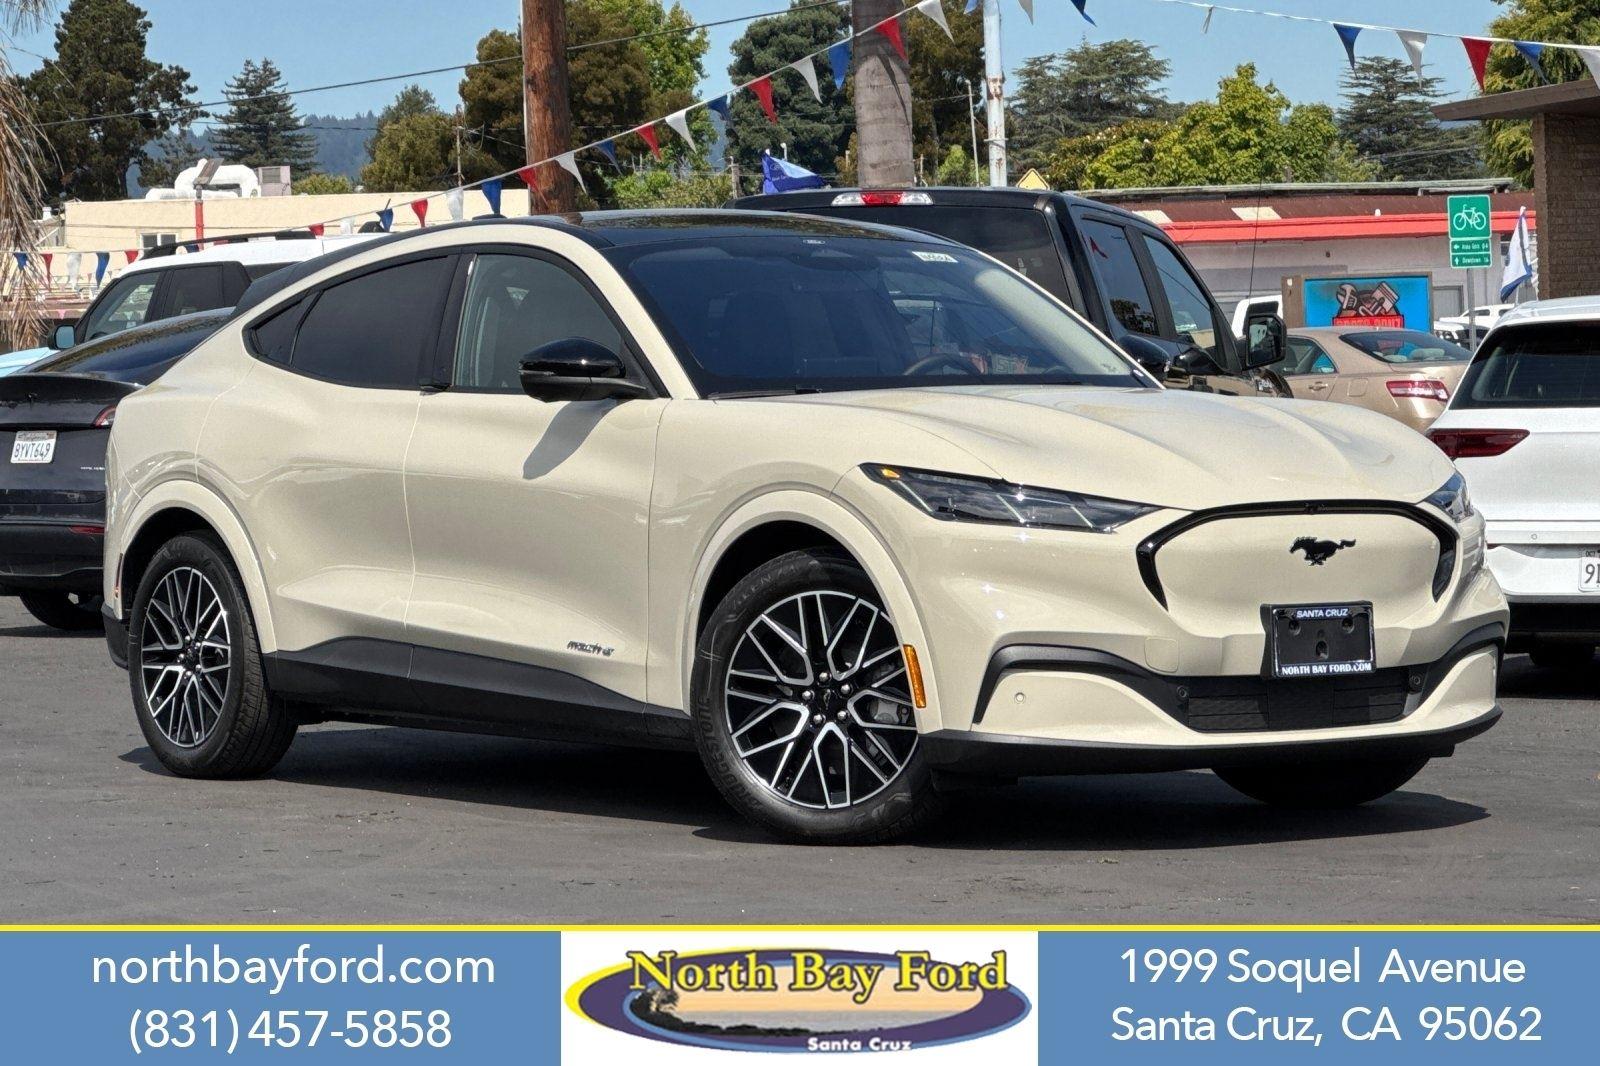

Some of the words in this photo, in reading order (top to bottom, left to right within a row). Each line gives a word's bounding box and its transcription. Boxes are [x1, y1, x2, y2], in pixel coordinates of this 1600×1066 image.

[14, 443, 51, 458] 8YVT649
[1297, 610, 1324, 618] SANTA
[1325, 608, 1348, 616] CRUZ
[1282, 665, 1310, 675] NORTH
[1312, 665, 1328, 674] BAY
[1329, 662, 1372, 674] FORD.COM
